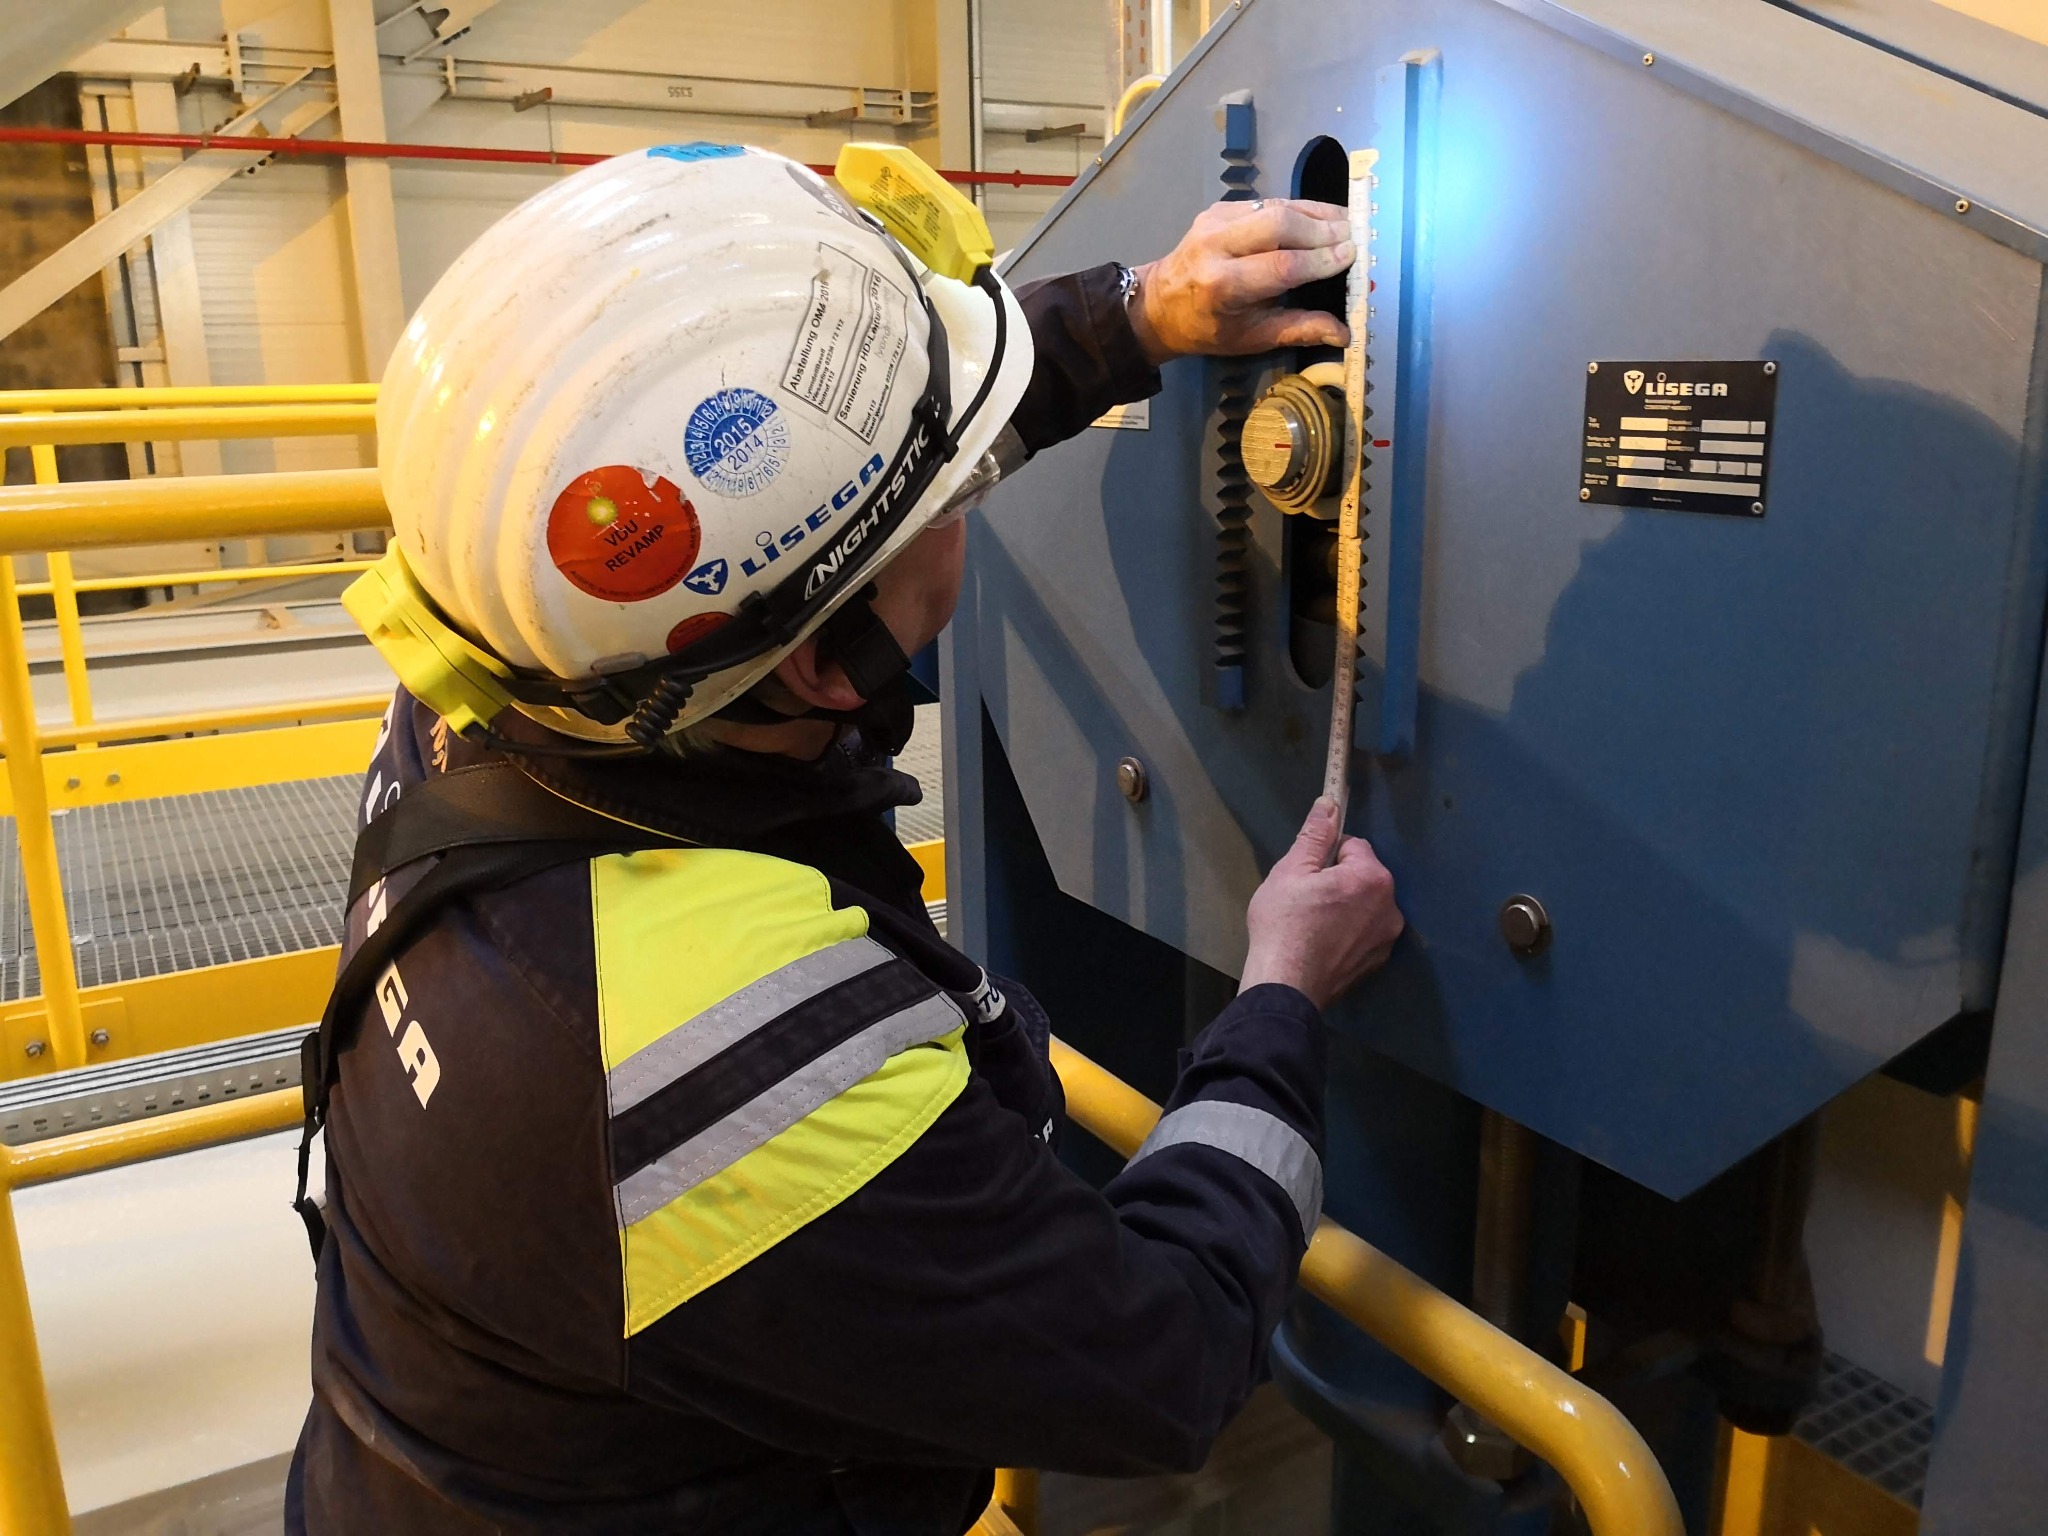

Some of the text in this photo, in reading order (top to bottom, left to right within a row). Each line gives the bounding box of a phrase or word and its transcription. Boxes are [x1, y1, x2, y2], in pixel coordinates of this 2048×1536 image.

[790, 331, 818, 391] Abstellung
[840, 363, 867, 420] Sanierung
[872, 275, 882, 300] 2016
[818, 370, 835, 406] Notruf 112
[1645, 372, 1728, 397] LISEGA
[695, 419, 709, 431] 5
[702, 409, 715, 421] 6
[714, 418, 753, 456] 2015
[728, 435, 764, 471] 2014
[816, 395, 940, 585] NIGHTSTIC
[604, 520, 638, 547] VDU
[740, 453, 885, 578] LISEGA
[605, 524, 664, 573] REVAMP
